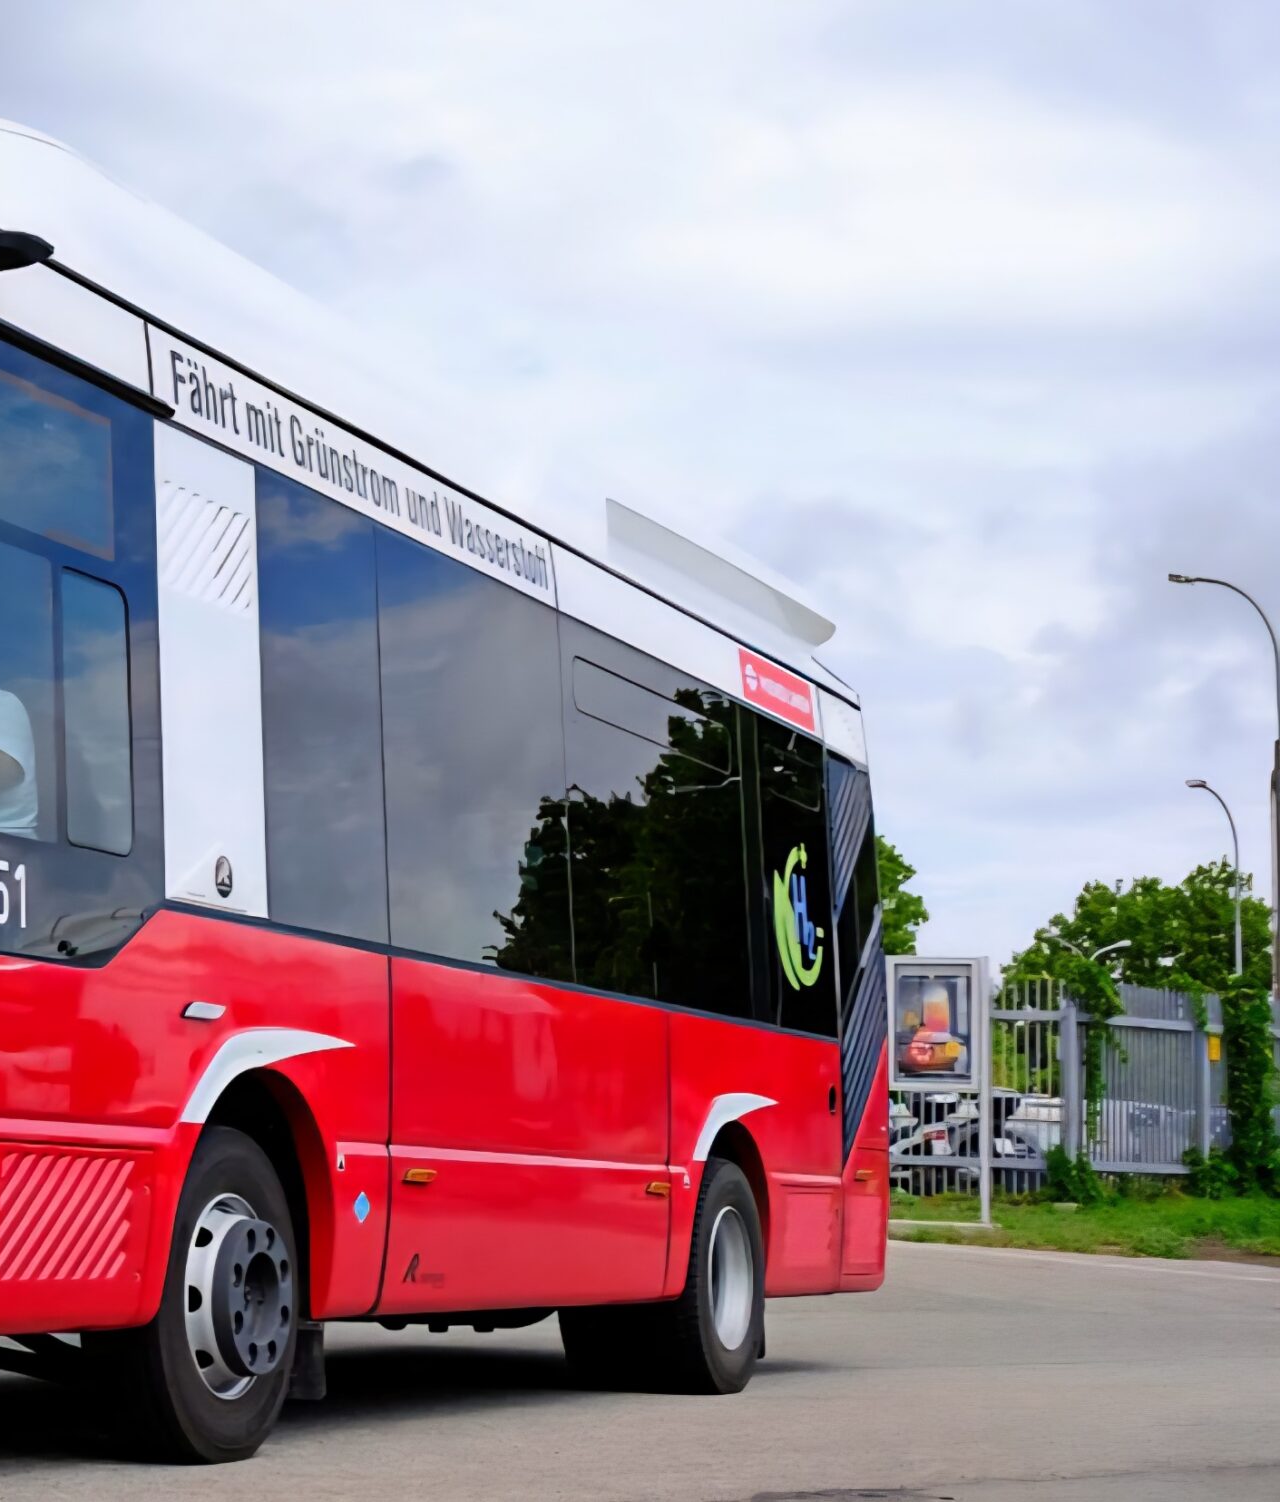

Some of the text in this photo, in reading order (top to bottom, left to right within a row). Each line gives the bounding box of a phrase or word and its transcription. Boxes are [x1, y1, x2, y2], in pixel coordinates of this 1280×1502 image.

[170, 350, 240, 435] Fährt
[245, 401, 285, 457] mit
[290, 414, 401, 517] Grünstrom
[405, 487, 442, 538] und
